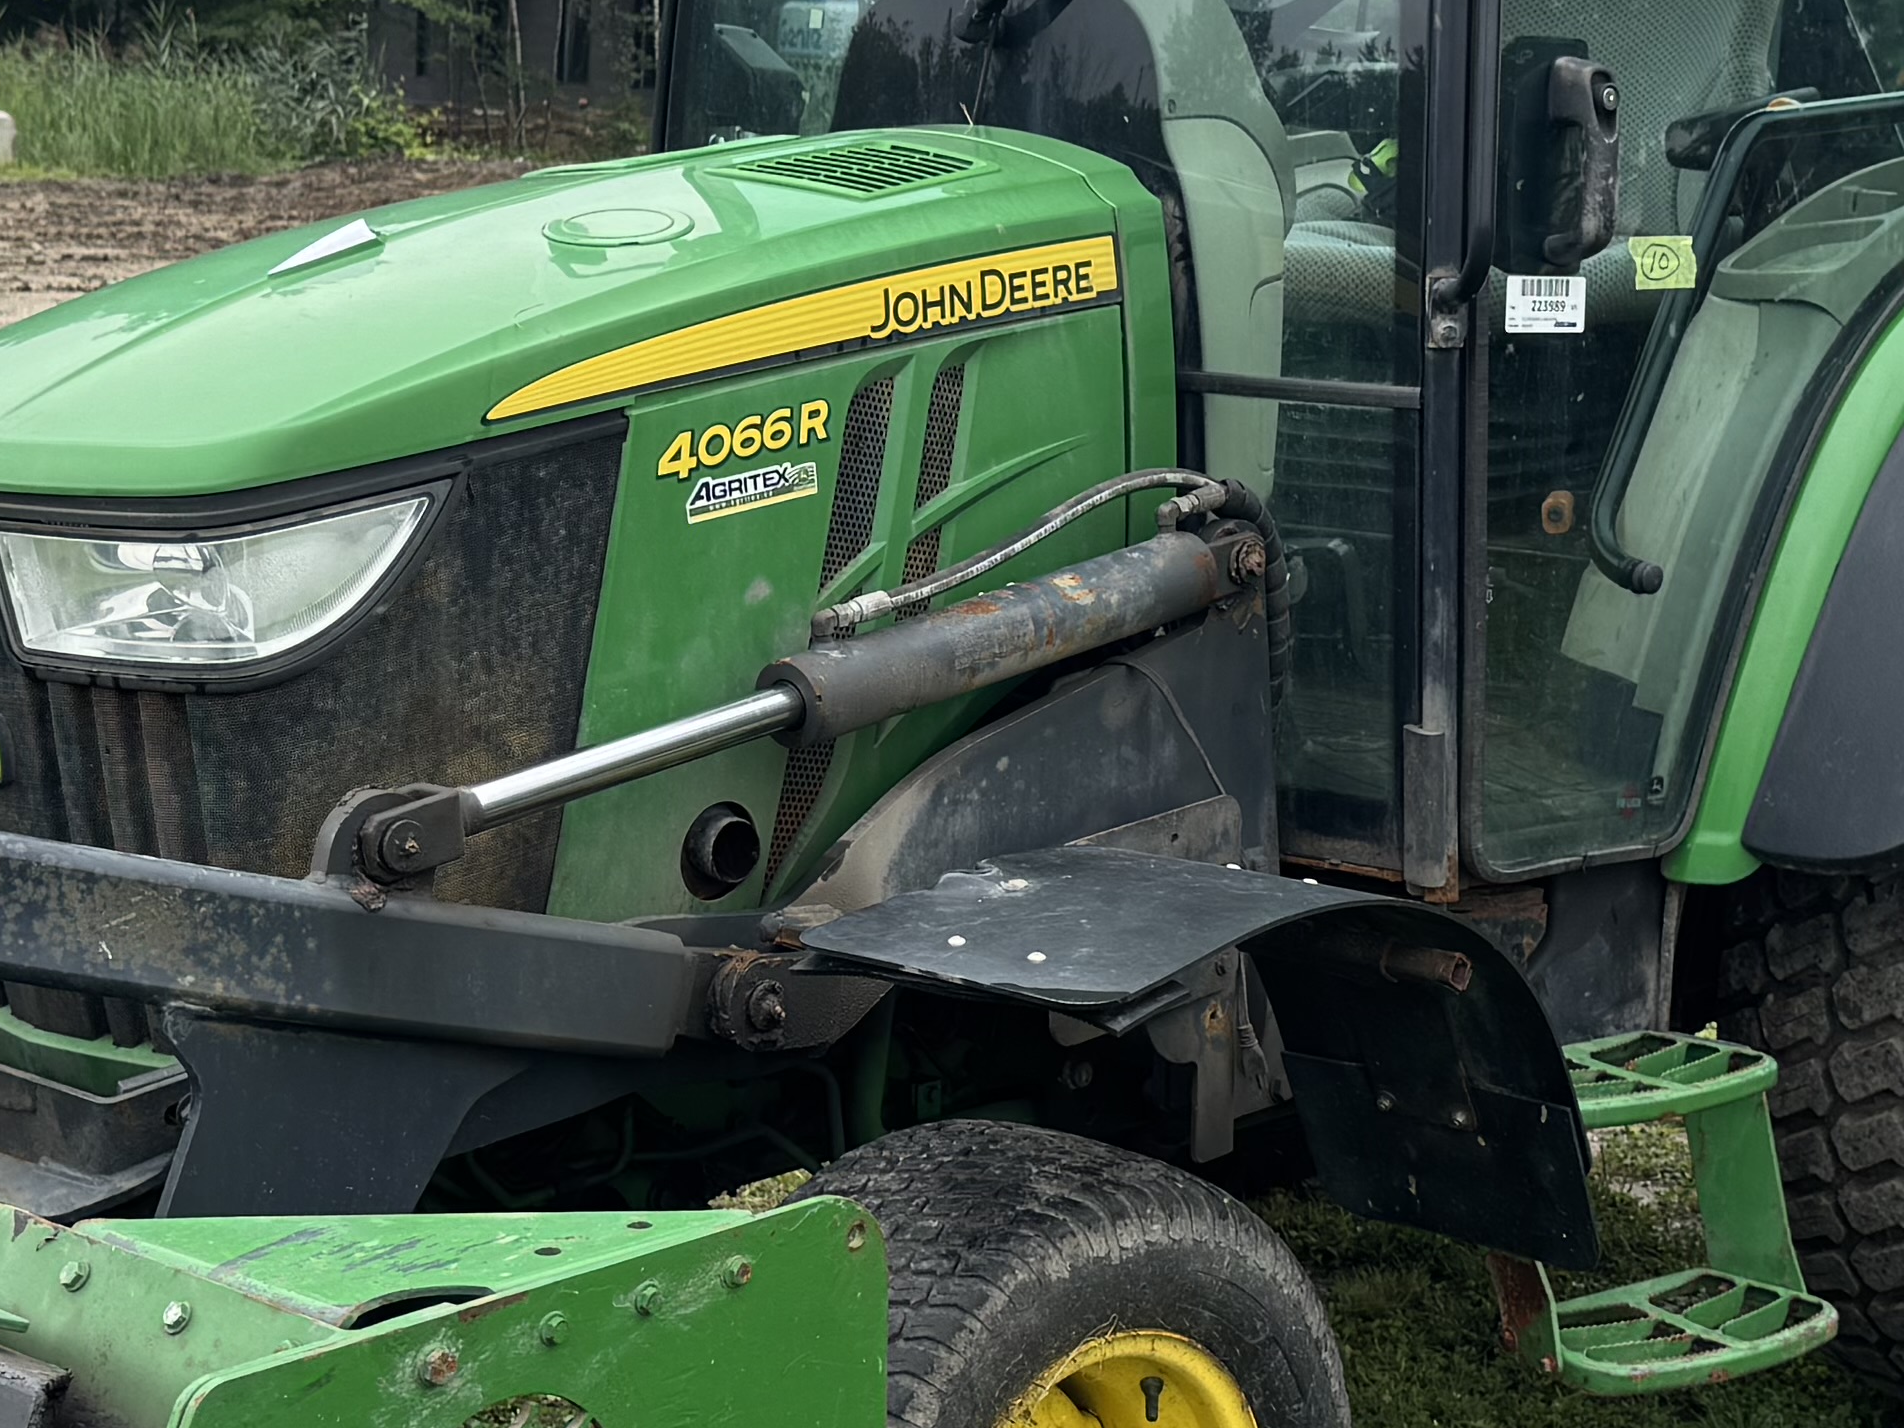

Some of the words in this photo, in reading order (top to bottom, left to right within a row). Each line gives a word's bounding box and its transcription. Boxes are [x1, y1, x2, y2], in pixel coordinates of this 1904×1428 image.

[1650, 250, 1669, 272] 10
[870, 280, 973, 334] JOHN
[979, 260, 1094, 313] DEERE
[657, 407, 793, 480] 4066
[689, 466, 790, 507] AGRITEX
